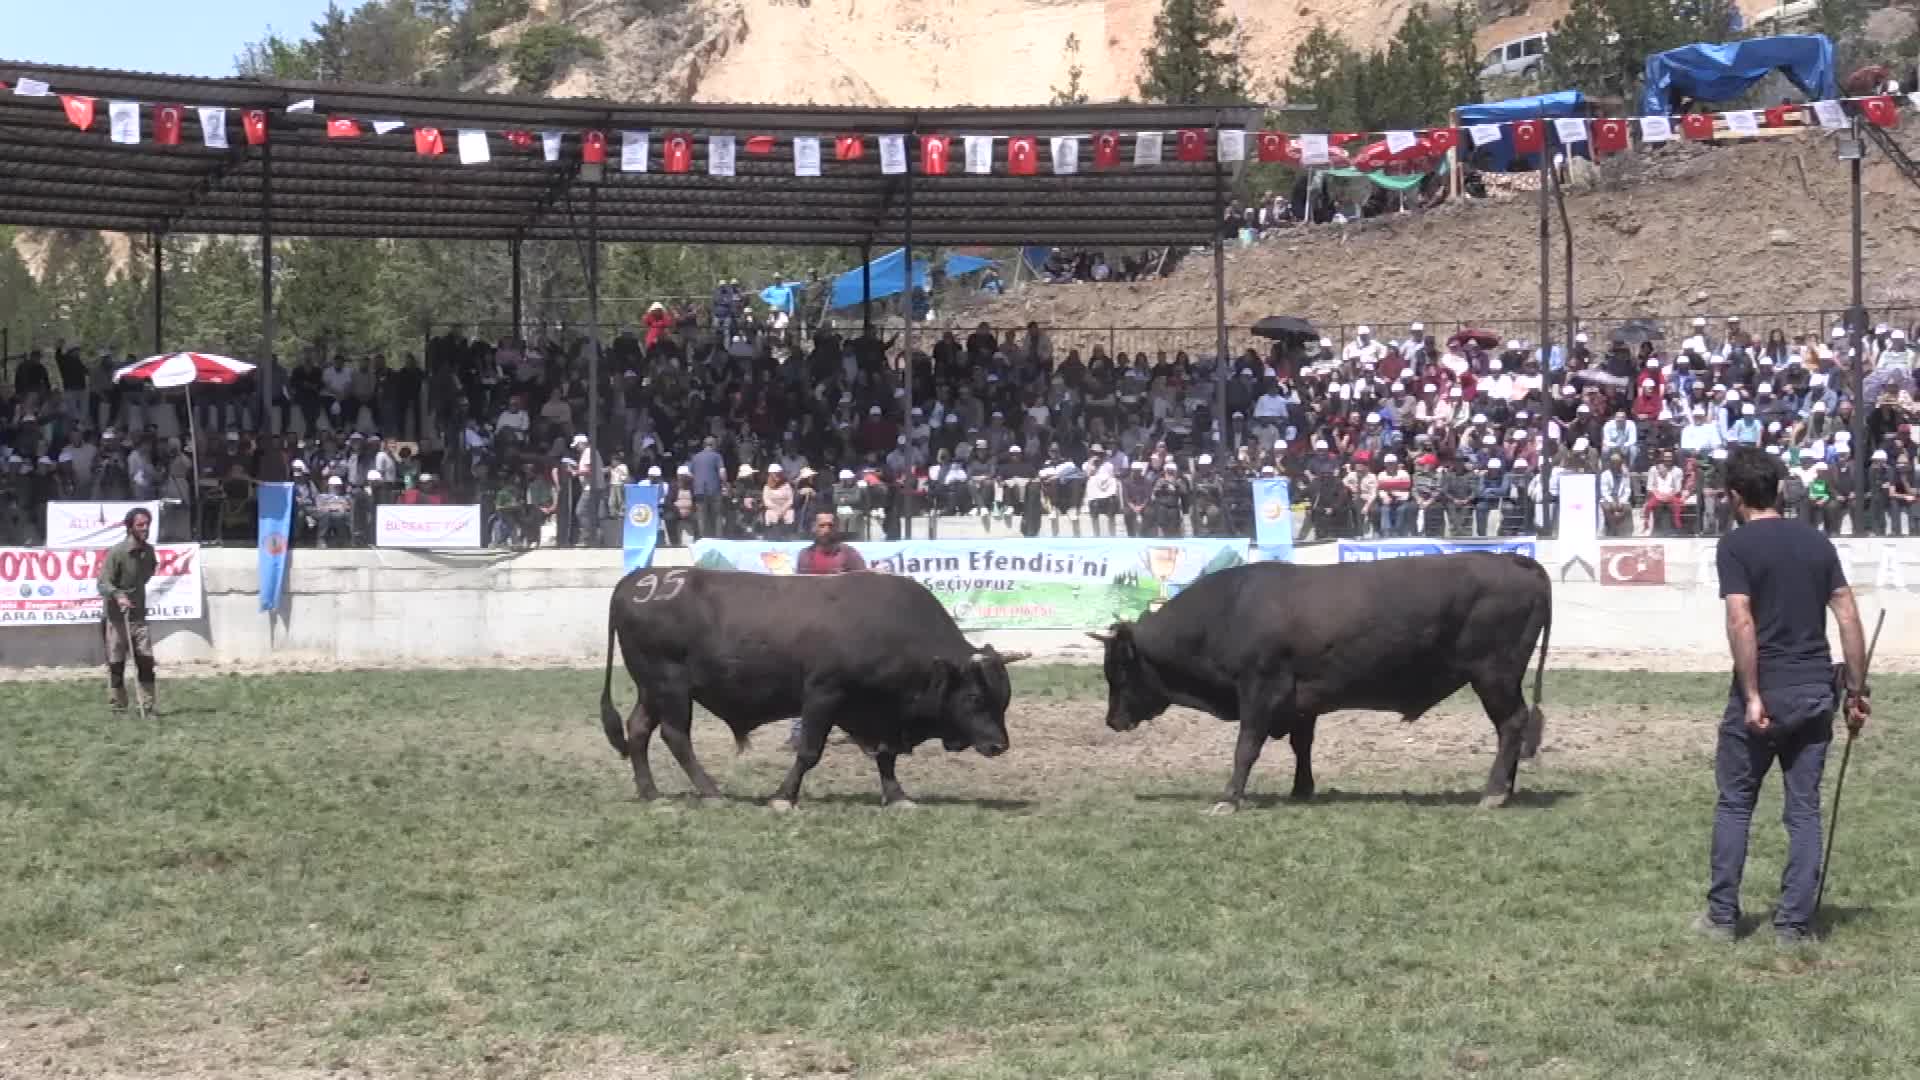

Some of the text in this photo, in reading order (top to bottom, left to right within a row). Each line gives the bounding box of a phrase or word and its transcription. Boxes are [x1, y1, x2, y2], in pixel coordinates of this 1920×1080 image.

[0, 550, 62, 581] OTO
[969, 550, 1108, 577] Efendisi'ni
[632, 569, 689, 603] 95
